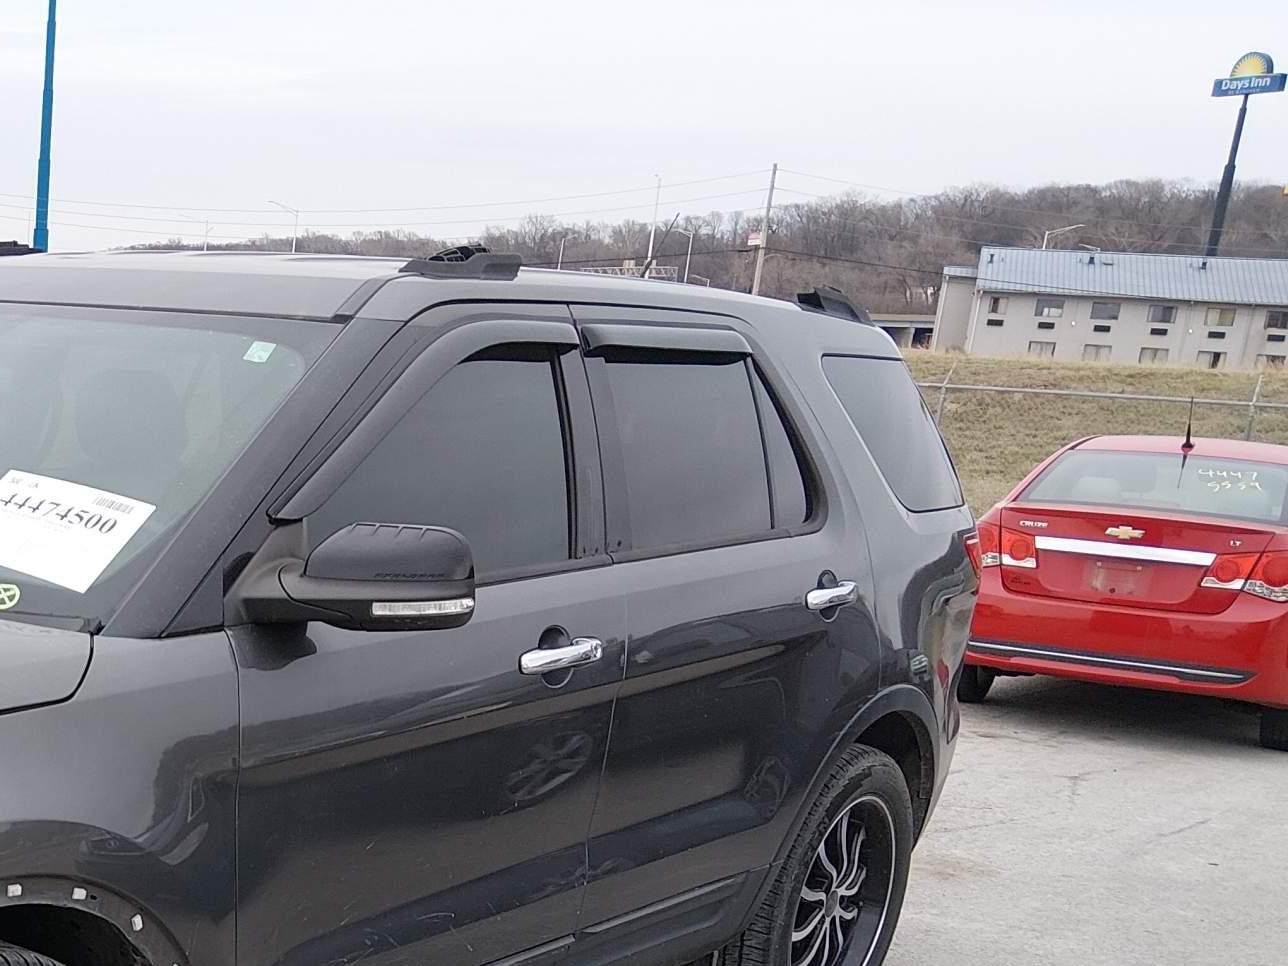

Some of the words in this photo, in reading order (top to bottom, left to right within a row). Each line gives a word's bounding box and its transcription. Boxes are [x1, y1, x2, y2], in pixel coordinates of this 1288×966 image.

[1221, 79, 1249, 90] Days
[1250, 77, 1271, 87] Inn
[1198, 469, 1258, 482] 4447
[0, 493, 118, 535] 44474500
